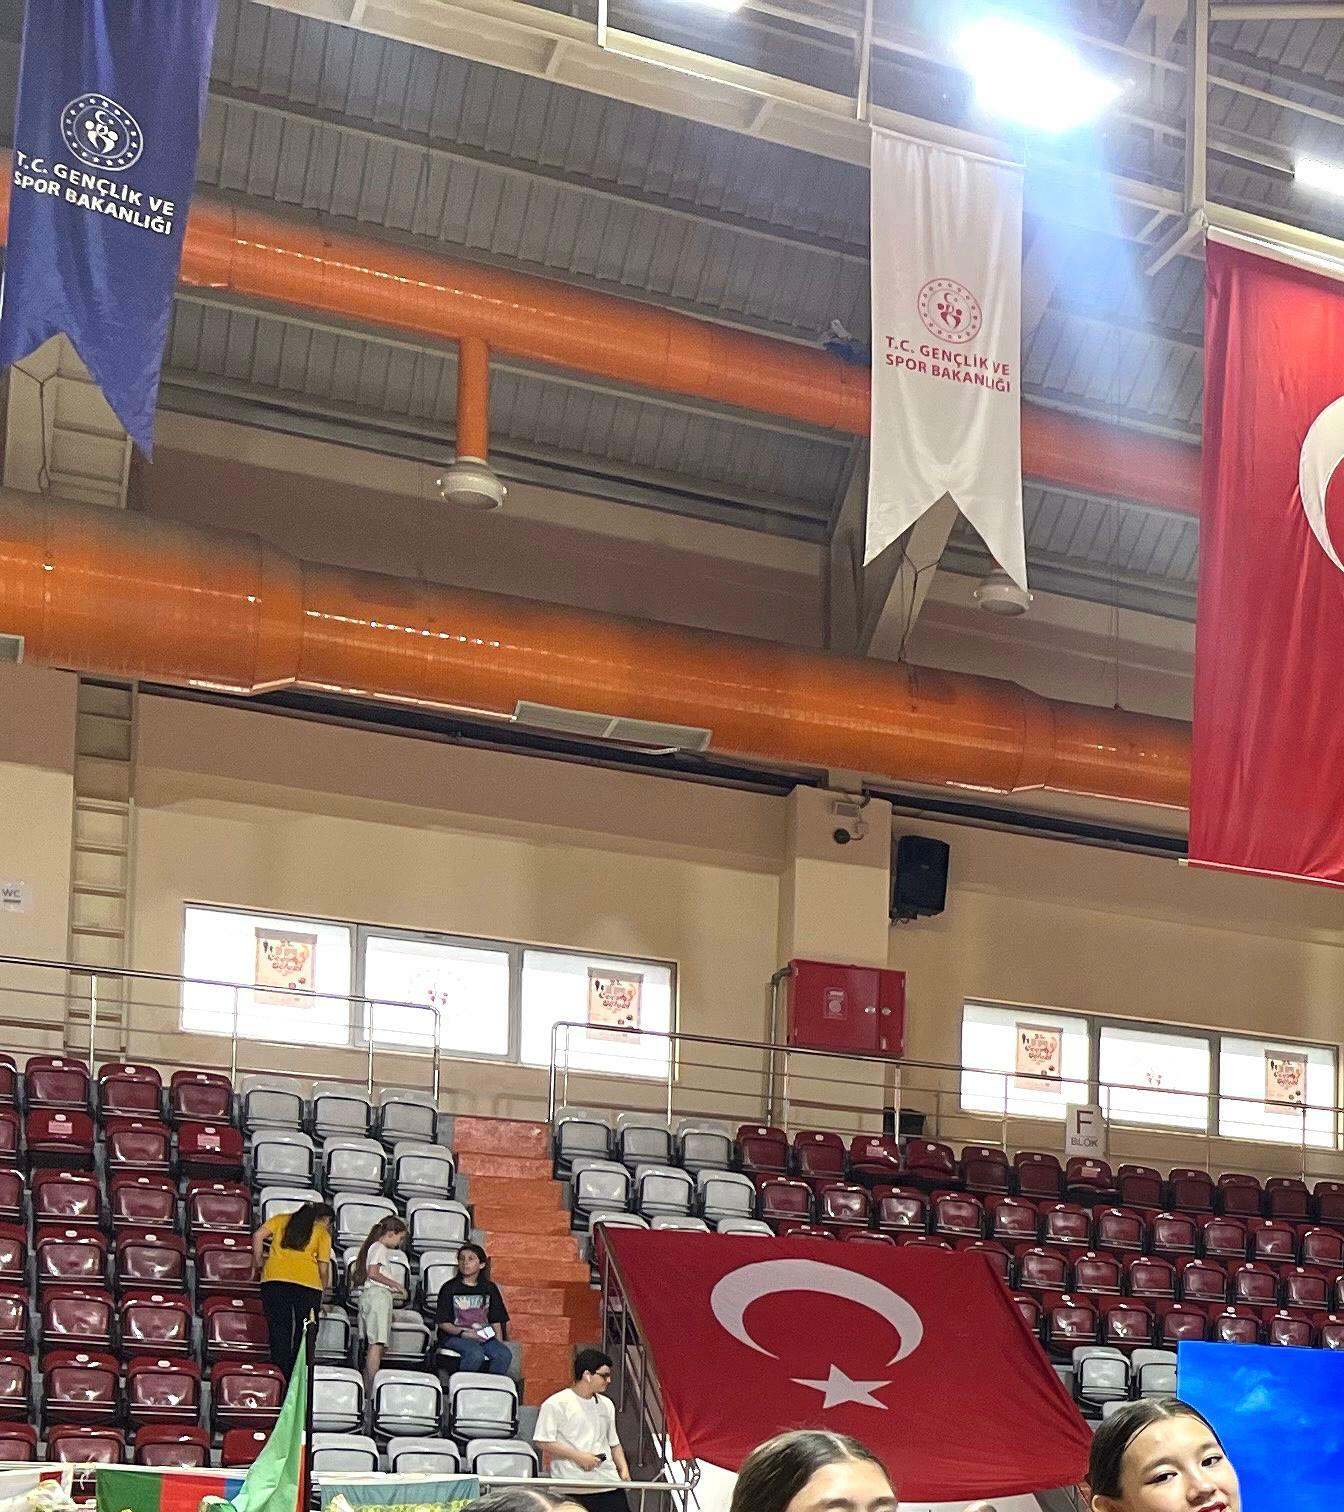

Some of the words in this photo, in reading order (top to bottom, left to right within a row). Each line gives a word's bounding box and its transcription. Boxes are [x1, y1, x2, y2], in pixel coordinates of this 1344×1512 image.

[16, 150, 48, 174] T.C.
[54, 163, 143, 206] GENÇLİK
[149, 195, 175, 216] VE
[14, 171, 61, 197] SPOR
[65, 188, 172, 235] BAKANLIĞI
[886, 336, 915, 353] T.C.
[920, 345, 988, 370] GENÇLİK
[993, 362, 1010, 375] VE
[886, 354, 927, 373] SPOR
[932, 364, 1010, 392] BAKANLIĞI
[1077, 1109, 1093, 1134] F
